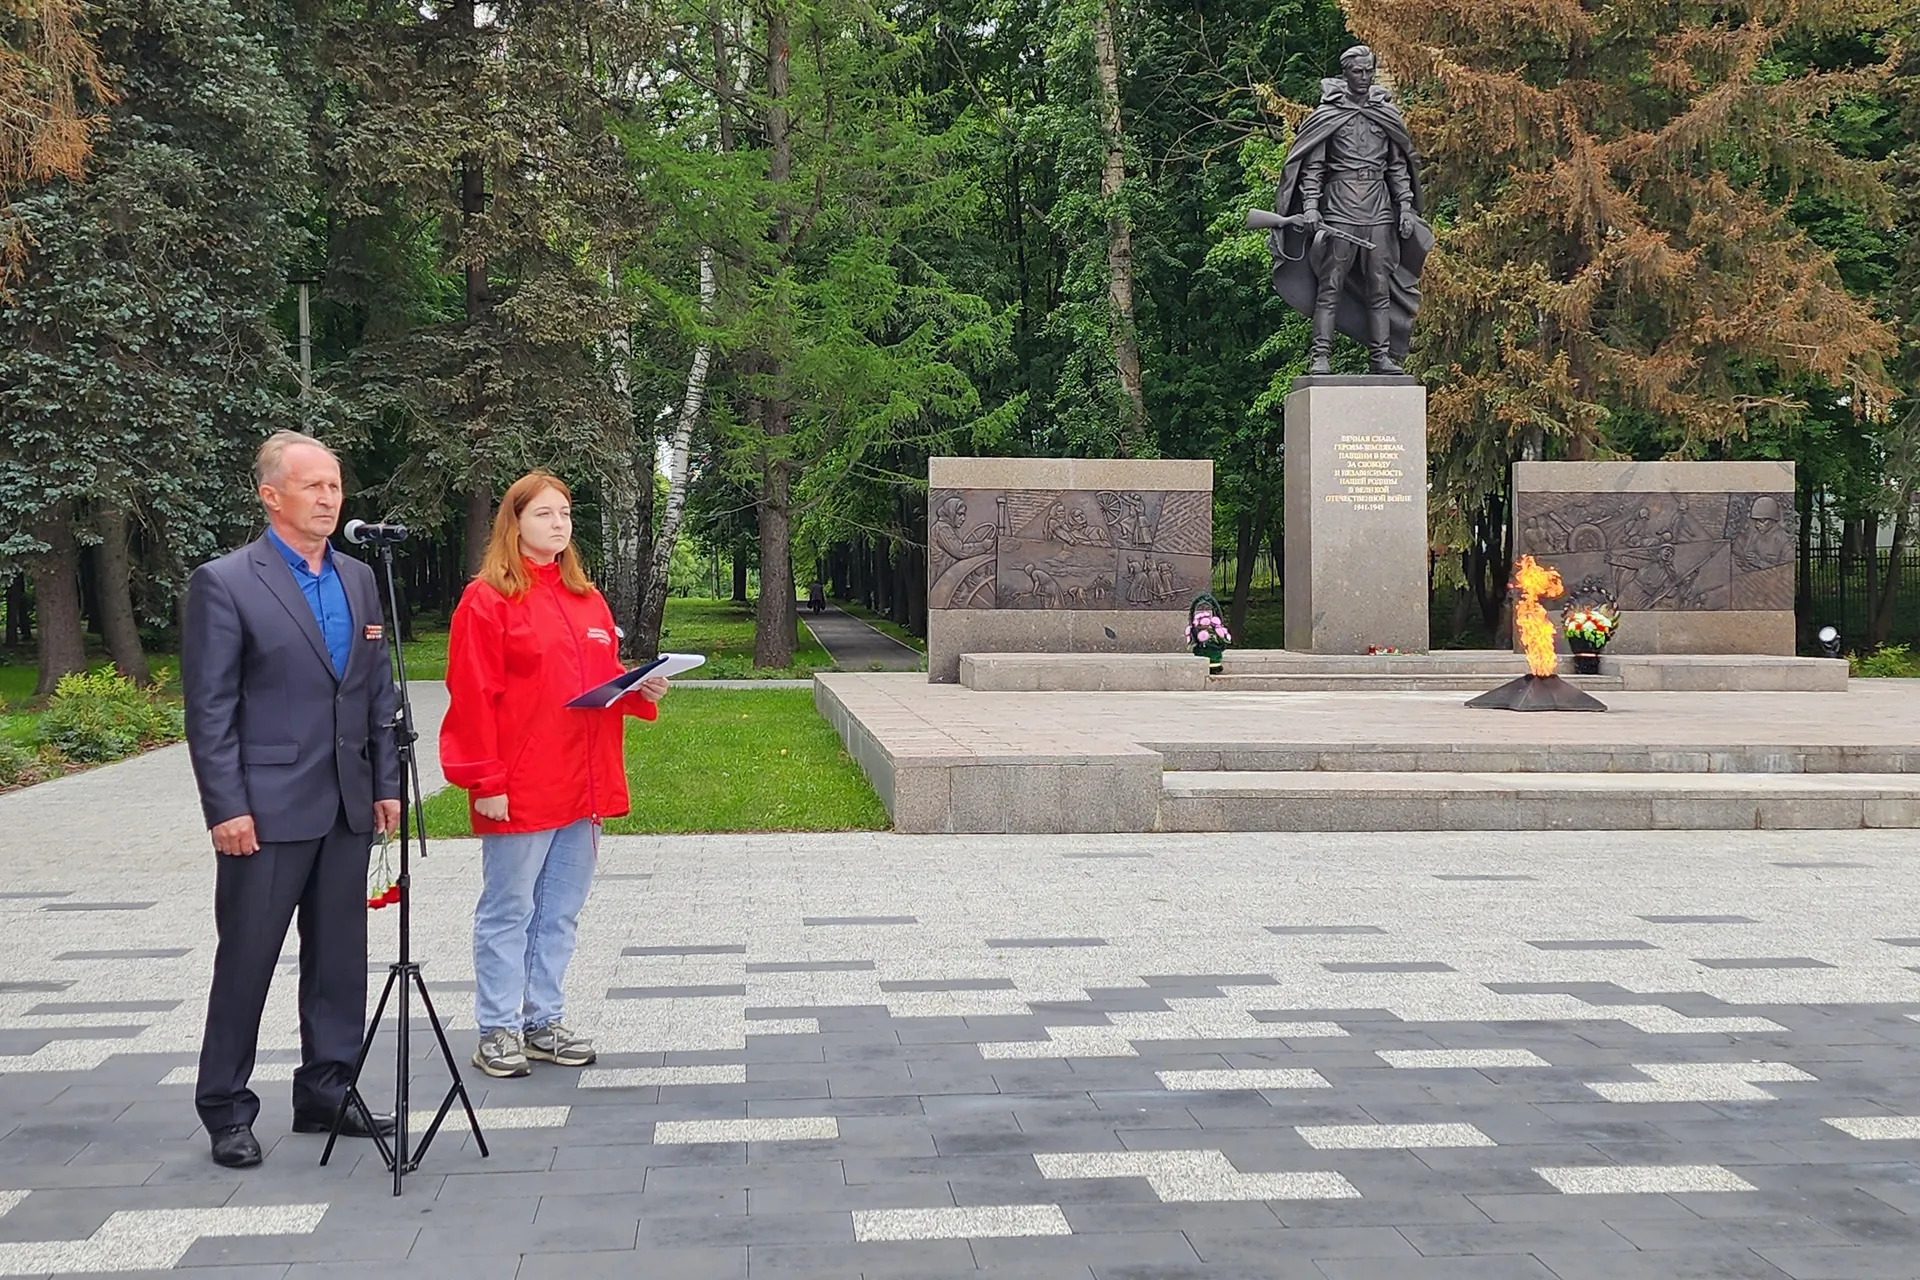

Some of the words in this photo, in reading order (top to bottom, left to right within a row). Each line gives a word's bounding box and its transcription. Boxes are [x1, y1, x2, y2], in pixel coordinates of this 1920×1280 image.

[1357, 461, 1391, 469] СВОБОДУ
[1341, 469, 1403, 477] НЕЗАВИСИМОСТЬ
[1339, 477, 1366, 485] НАШЕЙ
[1367, 478, 1398, 486] РОДИНЫ
[1355, 485, 1389, 494] ВЕЛИКОЙ
[1325, 494, 1386, 503] ОТЕЧЕСТВЕННОЙ
[1387, 494, 1412, 502] ВОЙНЕ
